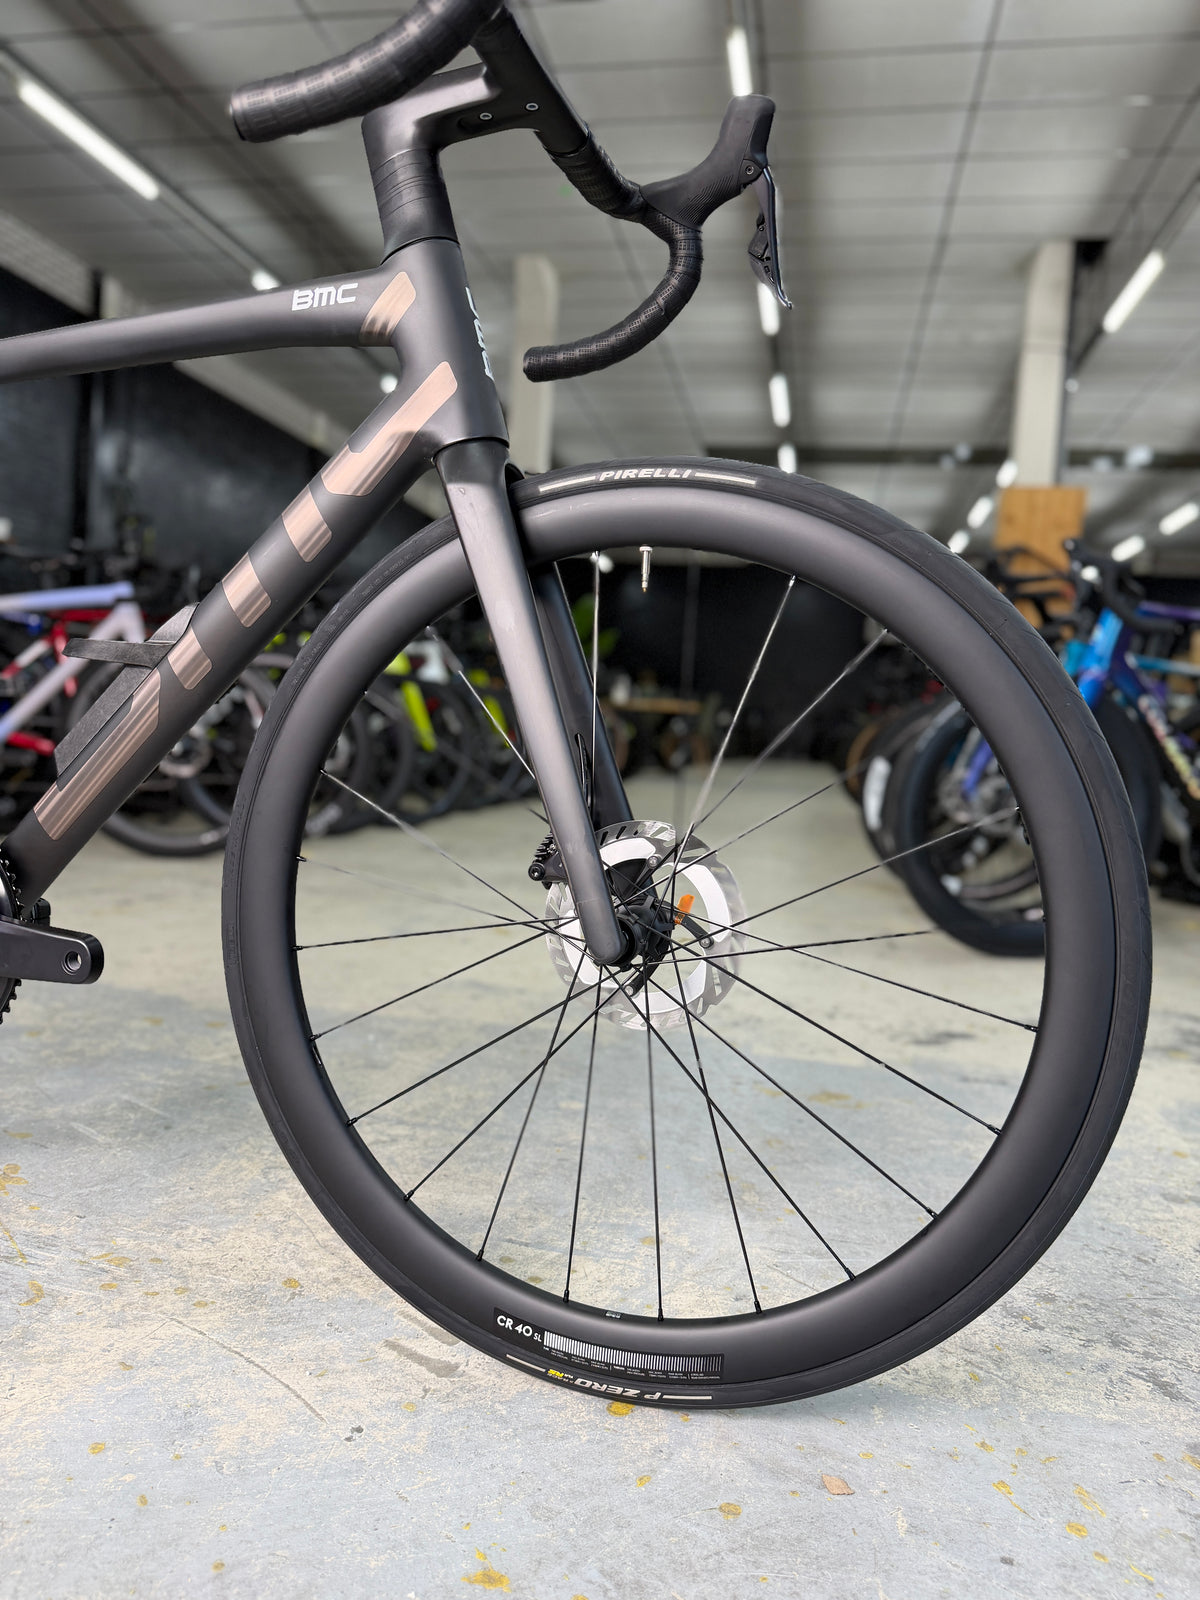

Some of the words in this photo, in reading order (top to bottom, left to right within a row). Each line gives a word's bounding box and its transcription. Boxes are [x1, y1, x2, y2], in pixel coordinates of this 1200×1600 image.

[292, 282, 359, 311] BMC
[599, 468, 693, 482] PIRELLI
[496, 1315, 514, 1330] CR
[514, 1324, 533, 1337] 40
[533, 1332, 543, 1342] SL
[574, 1378, 641, 1397] ZERO
[644, 1391, 662, 1401] P
